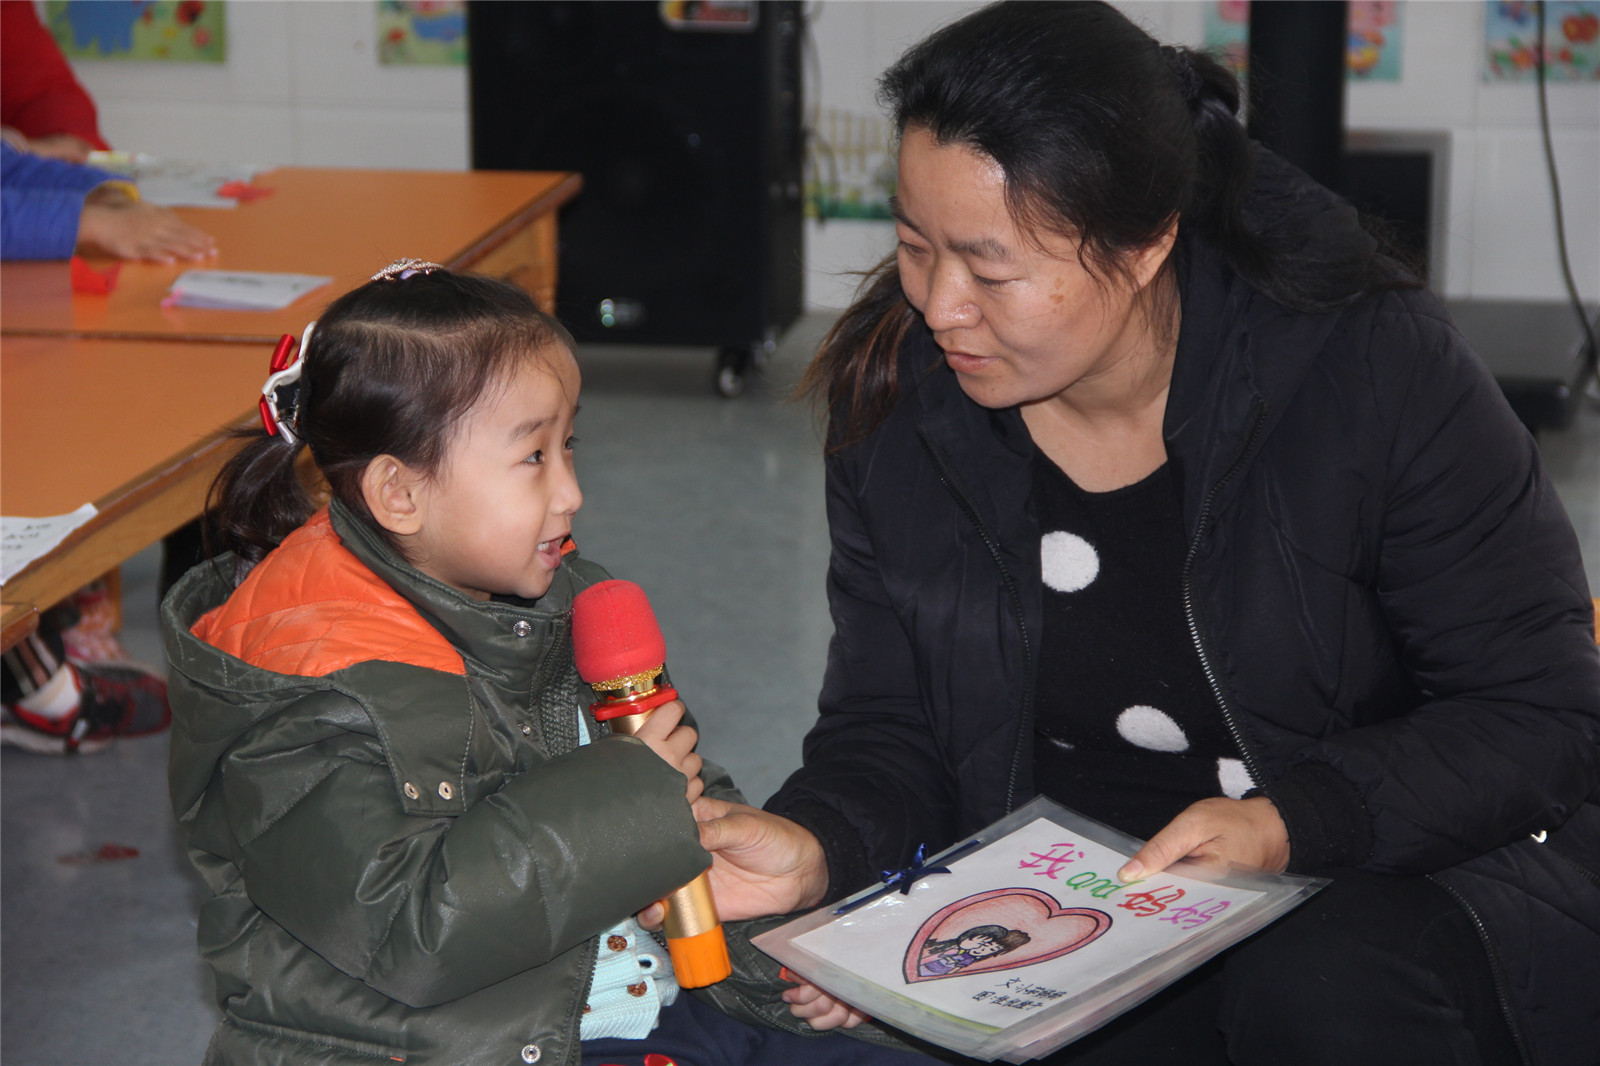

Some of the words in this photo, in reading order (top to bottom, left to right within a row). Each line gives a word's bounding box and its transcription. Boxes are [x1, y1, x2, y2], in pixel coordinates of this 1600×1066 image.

[1018, 843, 1085, 880] 我
[1066, 871, 1146, 900] and
[1116, 884, 1232, 930] 妈妈
